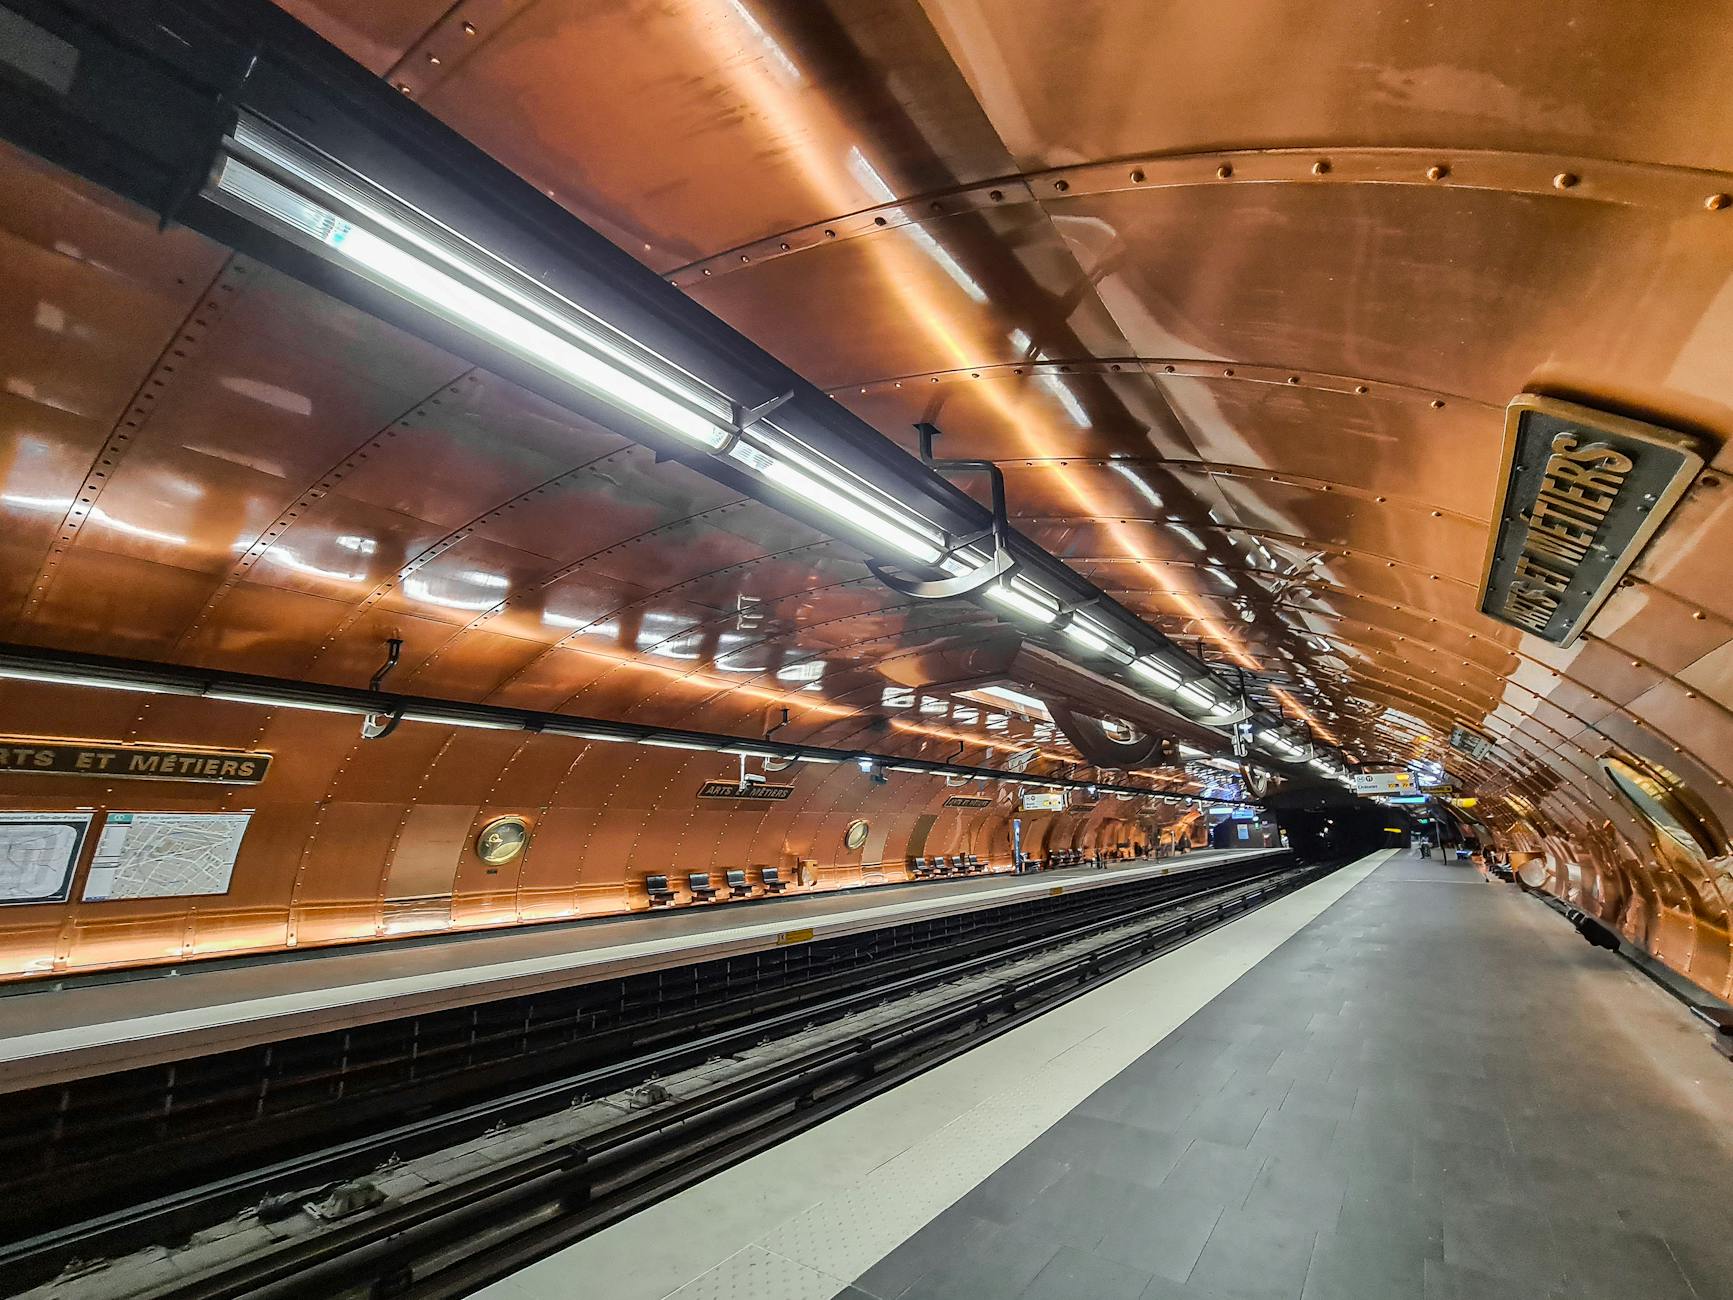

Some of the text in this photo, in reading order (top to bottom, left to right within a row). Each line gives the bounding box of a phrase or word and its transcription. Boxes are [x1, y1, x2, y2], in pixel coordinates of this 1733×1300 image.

[1504, 432, 1633, 632] ARTS ET MÉTIERS
[75, 752, 116, 769] ET
[129, 755, 255, 777] MÉTIERS
[705, 786, 733, 796] ARTS
